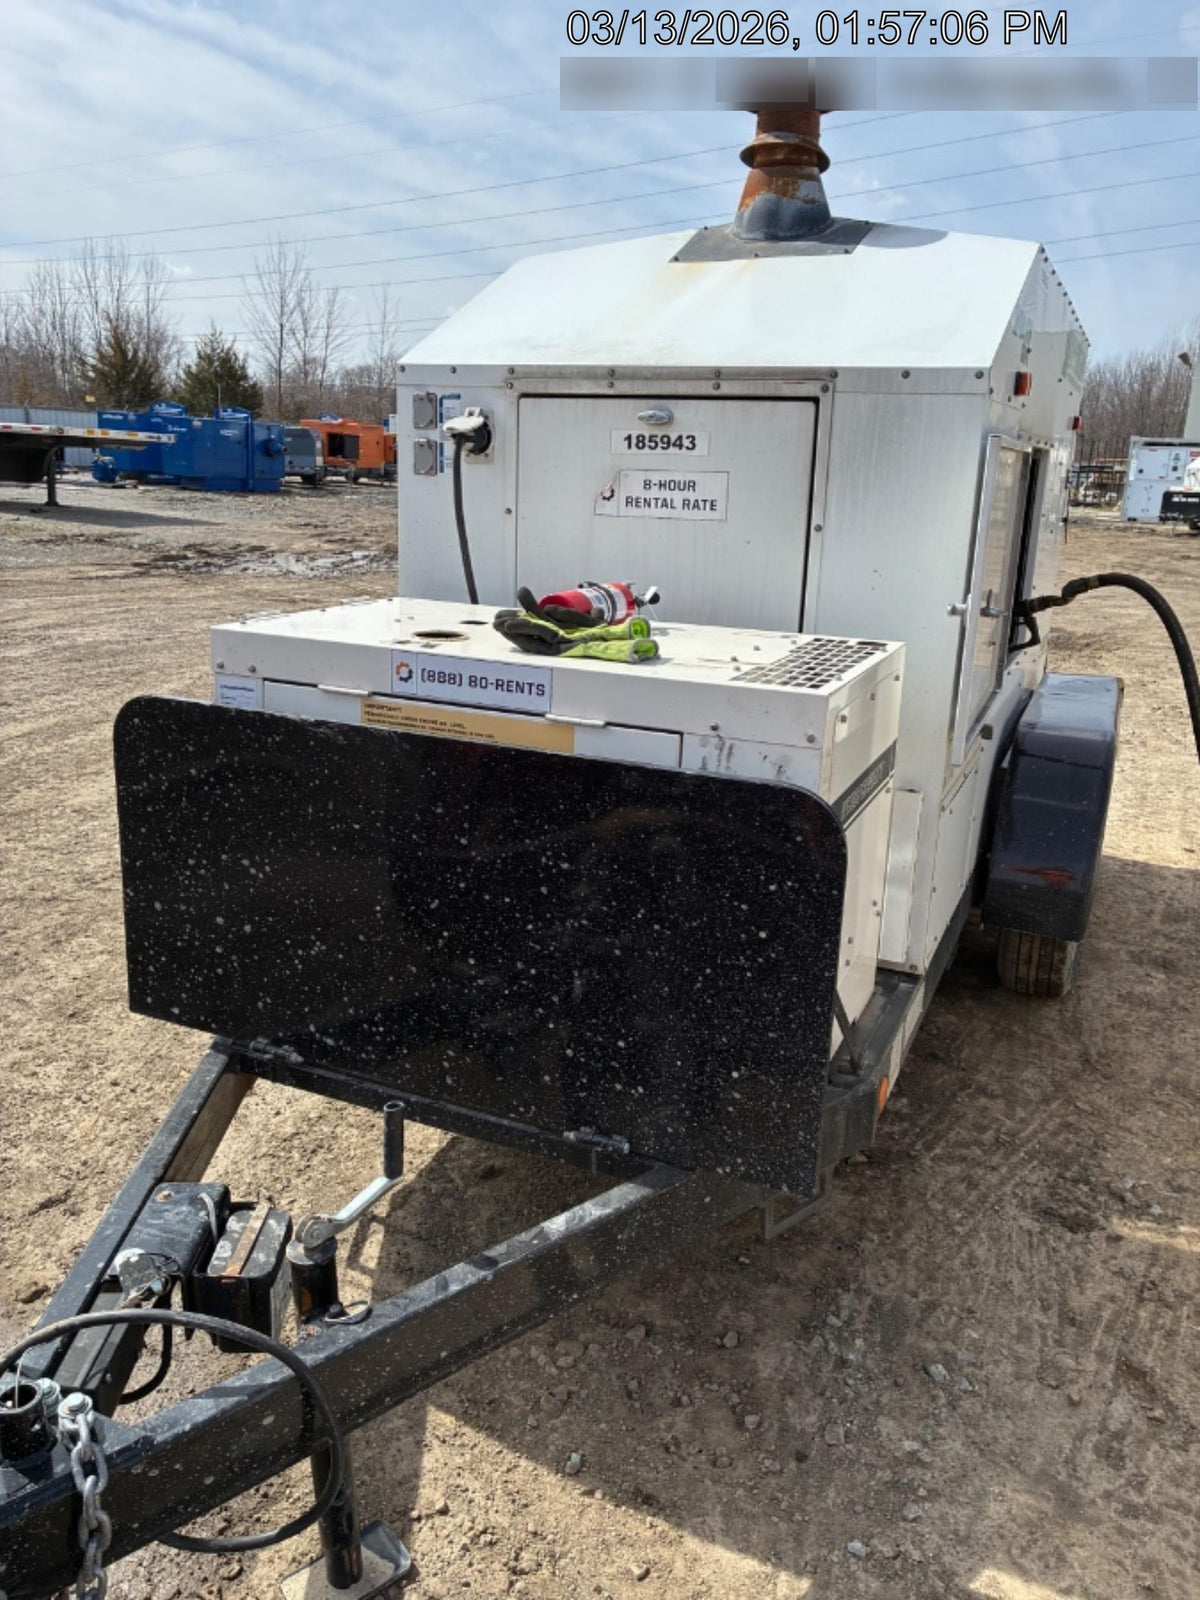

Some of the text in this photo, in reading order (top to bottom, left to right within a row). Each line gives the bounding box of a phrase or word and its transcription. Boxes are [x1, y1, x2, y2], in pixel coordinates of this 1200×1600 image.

[623, 433, 697, 450] 185943
[643, 479, 696, 492] 8-HOUR
[625, 496, 717, 511] RENTAL RATE
[420, 667, 546, 697] (888) 80-RENTS
